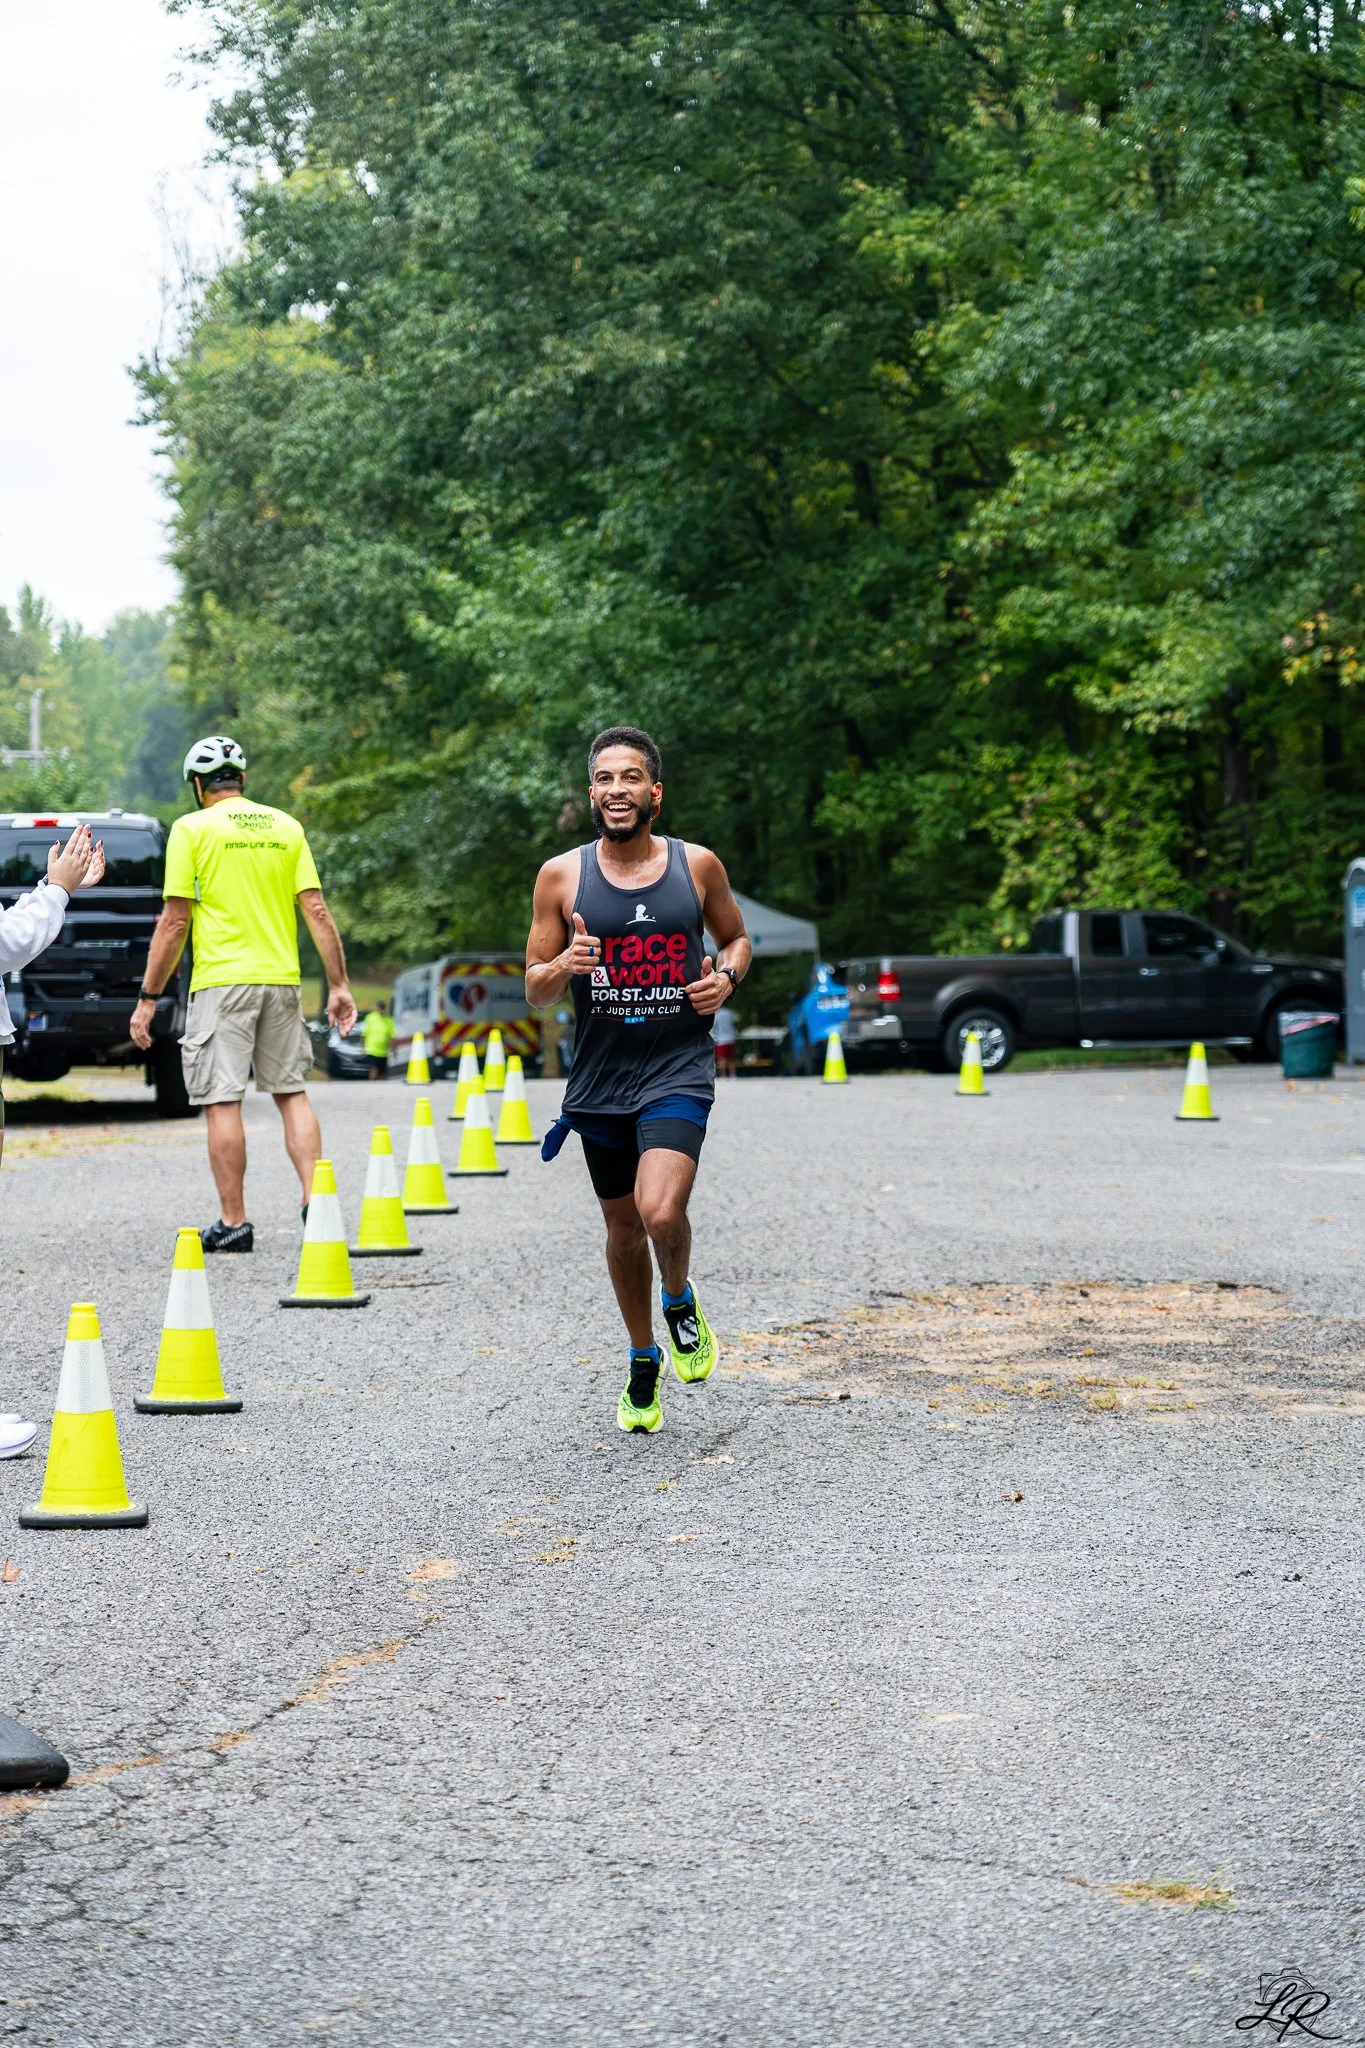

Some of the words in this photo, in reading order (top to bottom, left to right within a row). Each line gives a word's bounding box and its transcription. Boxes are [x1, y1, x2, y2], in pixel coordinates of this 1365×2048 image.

[605, 933, 687, 963] race
[593, 969, 605, 984] &
[609, 961, 687, 986] work
[591, 988, 619, 1002] FOR
[621, 988, 642, 1002] ST.
[645, 987, 686, 1001] JUDE
[591, 1006, 604, 1014] ST.
[607, 1006, 631, 1016] JUDE
[634, 1006, 655, 1016] RUN
[657, 1005, 681, 1014] CLUB
